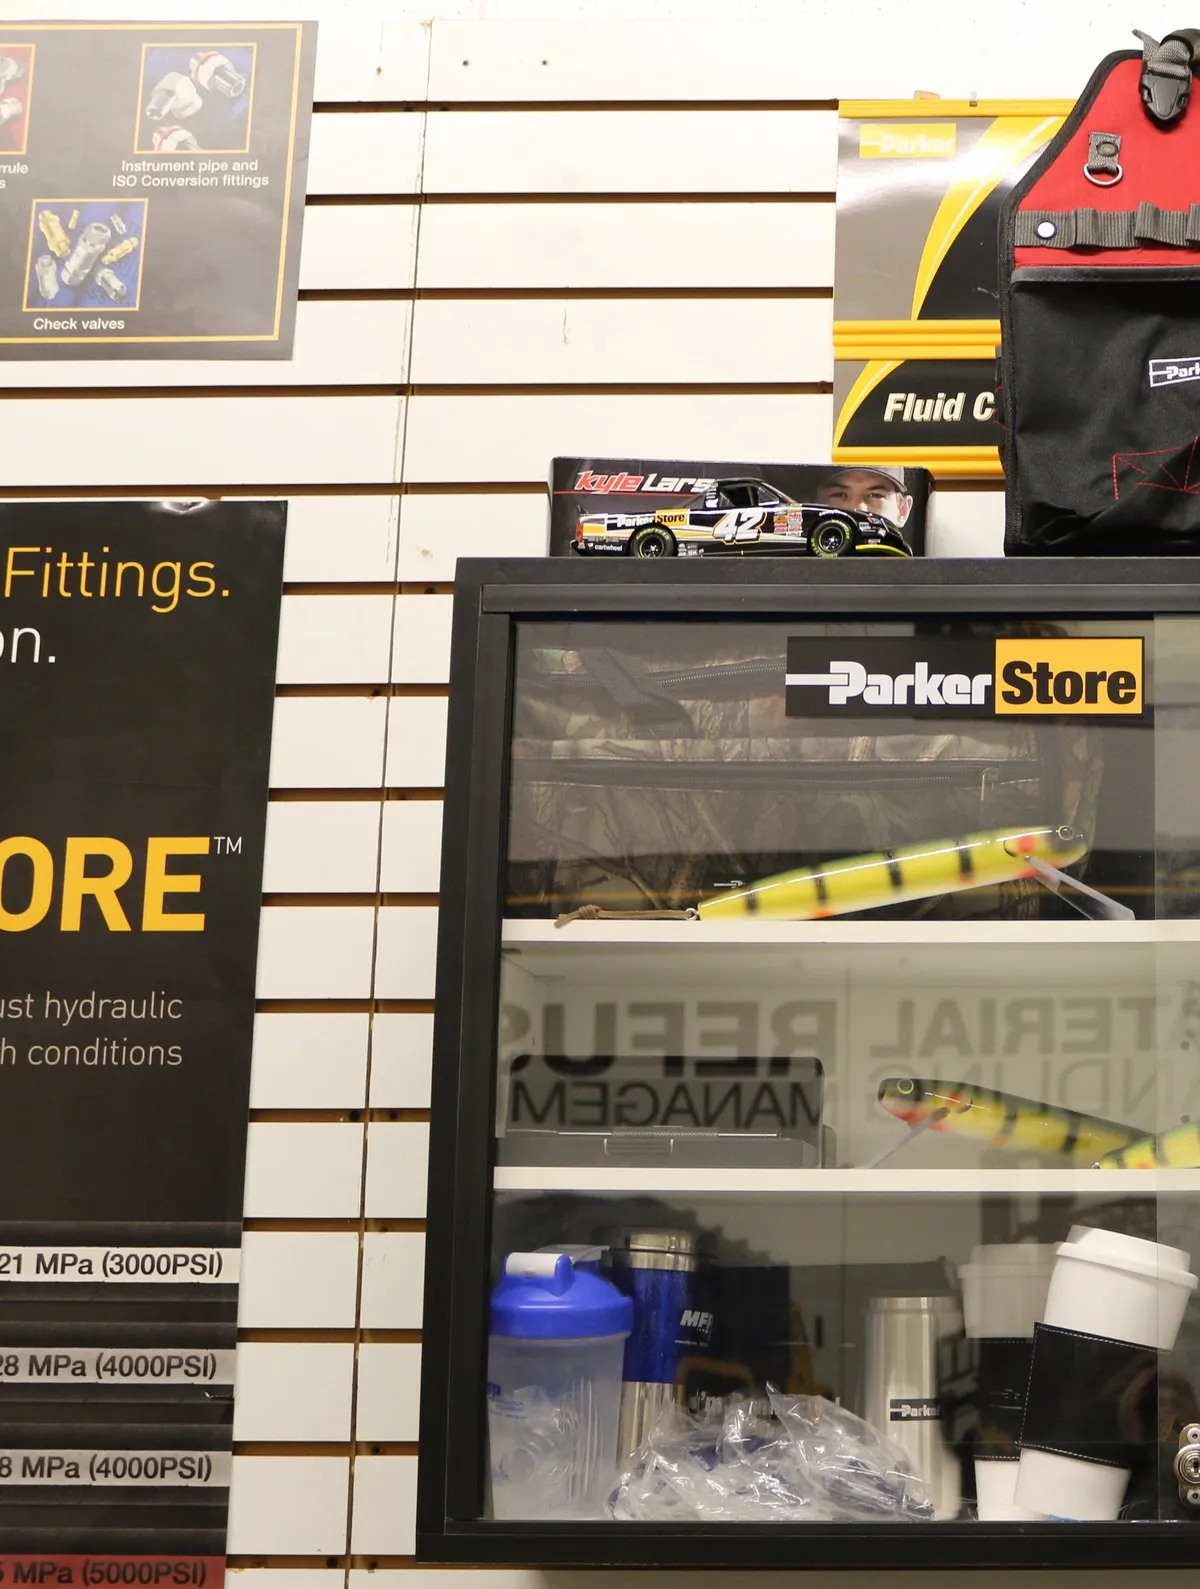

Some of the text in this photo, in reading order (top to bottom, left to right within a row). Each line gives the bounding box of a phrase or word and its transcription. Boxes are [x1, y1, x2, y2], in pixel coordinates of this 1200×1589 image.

[112, 174, 269, 189] ISO Conversion fittings
[122, 160, 258, 175] Instrument pipe and
[33, 318, 125, 330] Check valves
[883, 391, 966, 421] Fluid
[657, 513, 685, 524] Store
[712, 511, 766, 545] 42
[4, 546, 229, 613] Fittings.
[0, 627, 56, 663] n.
[829, 660, 1137, 705] Parker Store
[0, 836, 210, 932] ORE
[44, 991, 183, 1027] hydraulic
[27, 1037, 183, 1066] conditions
[0, 1251, 224, 1278] 21 MPa (3000PSI)
[28, 1354, 87, 1377] MPa
[95, 1352, 217, 1380] (4000PSI)
[21, 1456, 80, 1479] MPa
[89, 1454, 212, 1481] (4000PSI)
[13, 1561, 73, 1584] MPa
[82, 1559, 207, 1587] (5000PSI)
